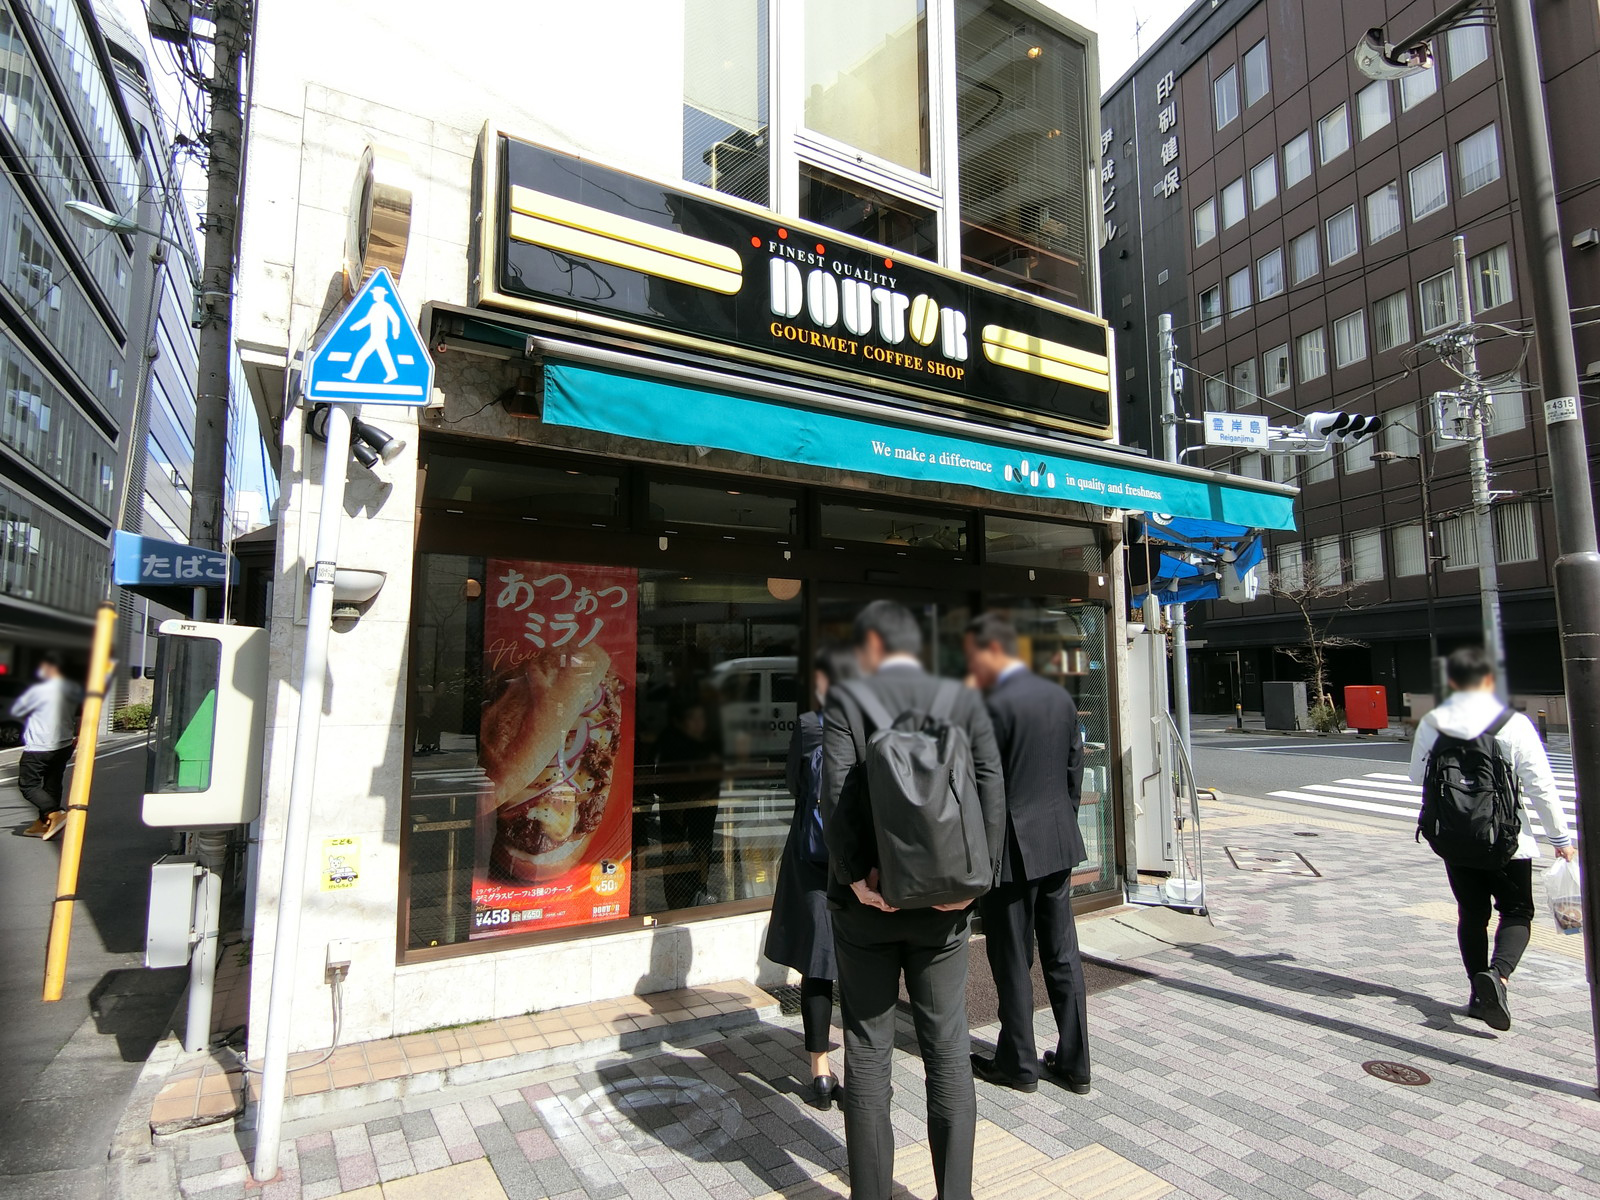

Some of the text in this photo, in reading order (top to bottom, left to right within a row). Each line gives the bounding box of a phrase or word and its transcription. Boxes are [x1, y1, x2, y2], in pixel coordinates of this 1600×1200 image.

[1156, 70, 1182, 199] 印刷健保
[769, 240, 898, 289] FINEST QUALITY
[769, 257, 968, 362] DOUTOR
[770, 322, 965, 381] GOURMET COFFEE SHOP
[1552, 399, 1574, 409] 4315
[1219, 433, 1255, 444] Reiganjima
[872, 440, 1162, 500] We make a difference in quality and freshness
[142, 554, 227, 579] たばこ
[524, 613, 604, 649] ミラノ
[489, 638, 541, 672] New
[475, 908, 510, 927] ¥458
